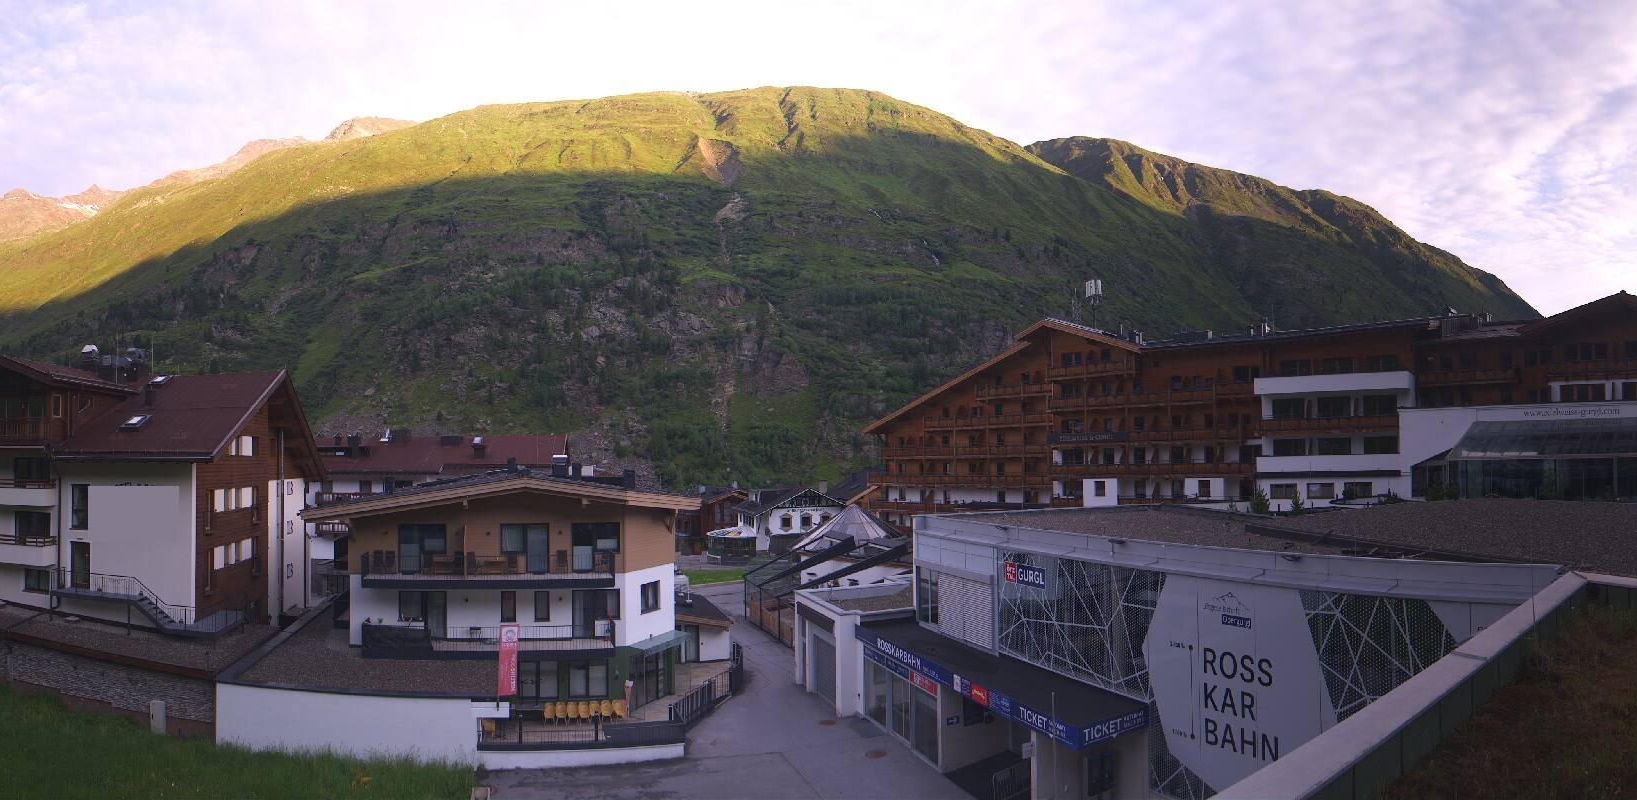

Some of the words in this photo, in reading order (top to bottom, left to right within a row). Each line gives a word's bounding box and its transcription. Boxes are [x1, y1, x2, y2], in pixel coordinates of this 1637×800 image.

[1018, 568, 1045, 585] GURGL
[876, 637, 921, 671] ROSSKARBAHN
[1203, 647, 1273, 687] ROSS
[1019, 706, 1048, 730] TICKET
[1203, 682, 1257, 721] KAR
[1084, 718, 1123, 742] TICKET
[1204, 717, 1279, 762] BAHN
